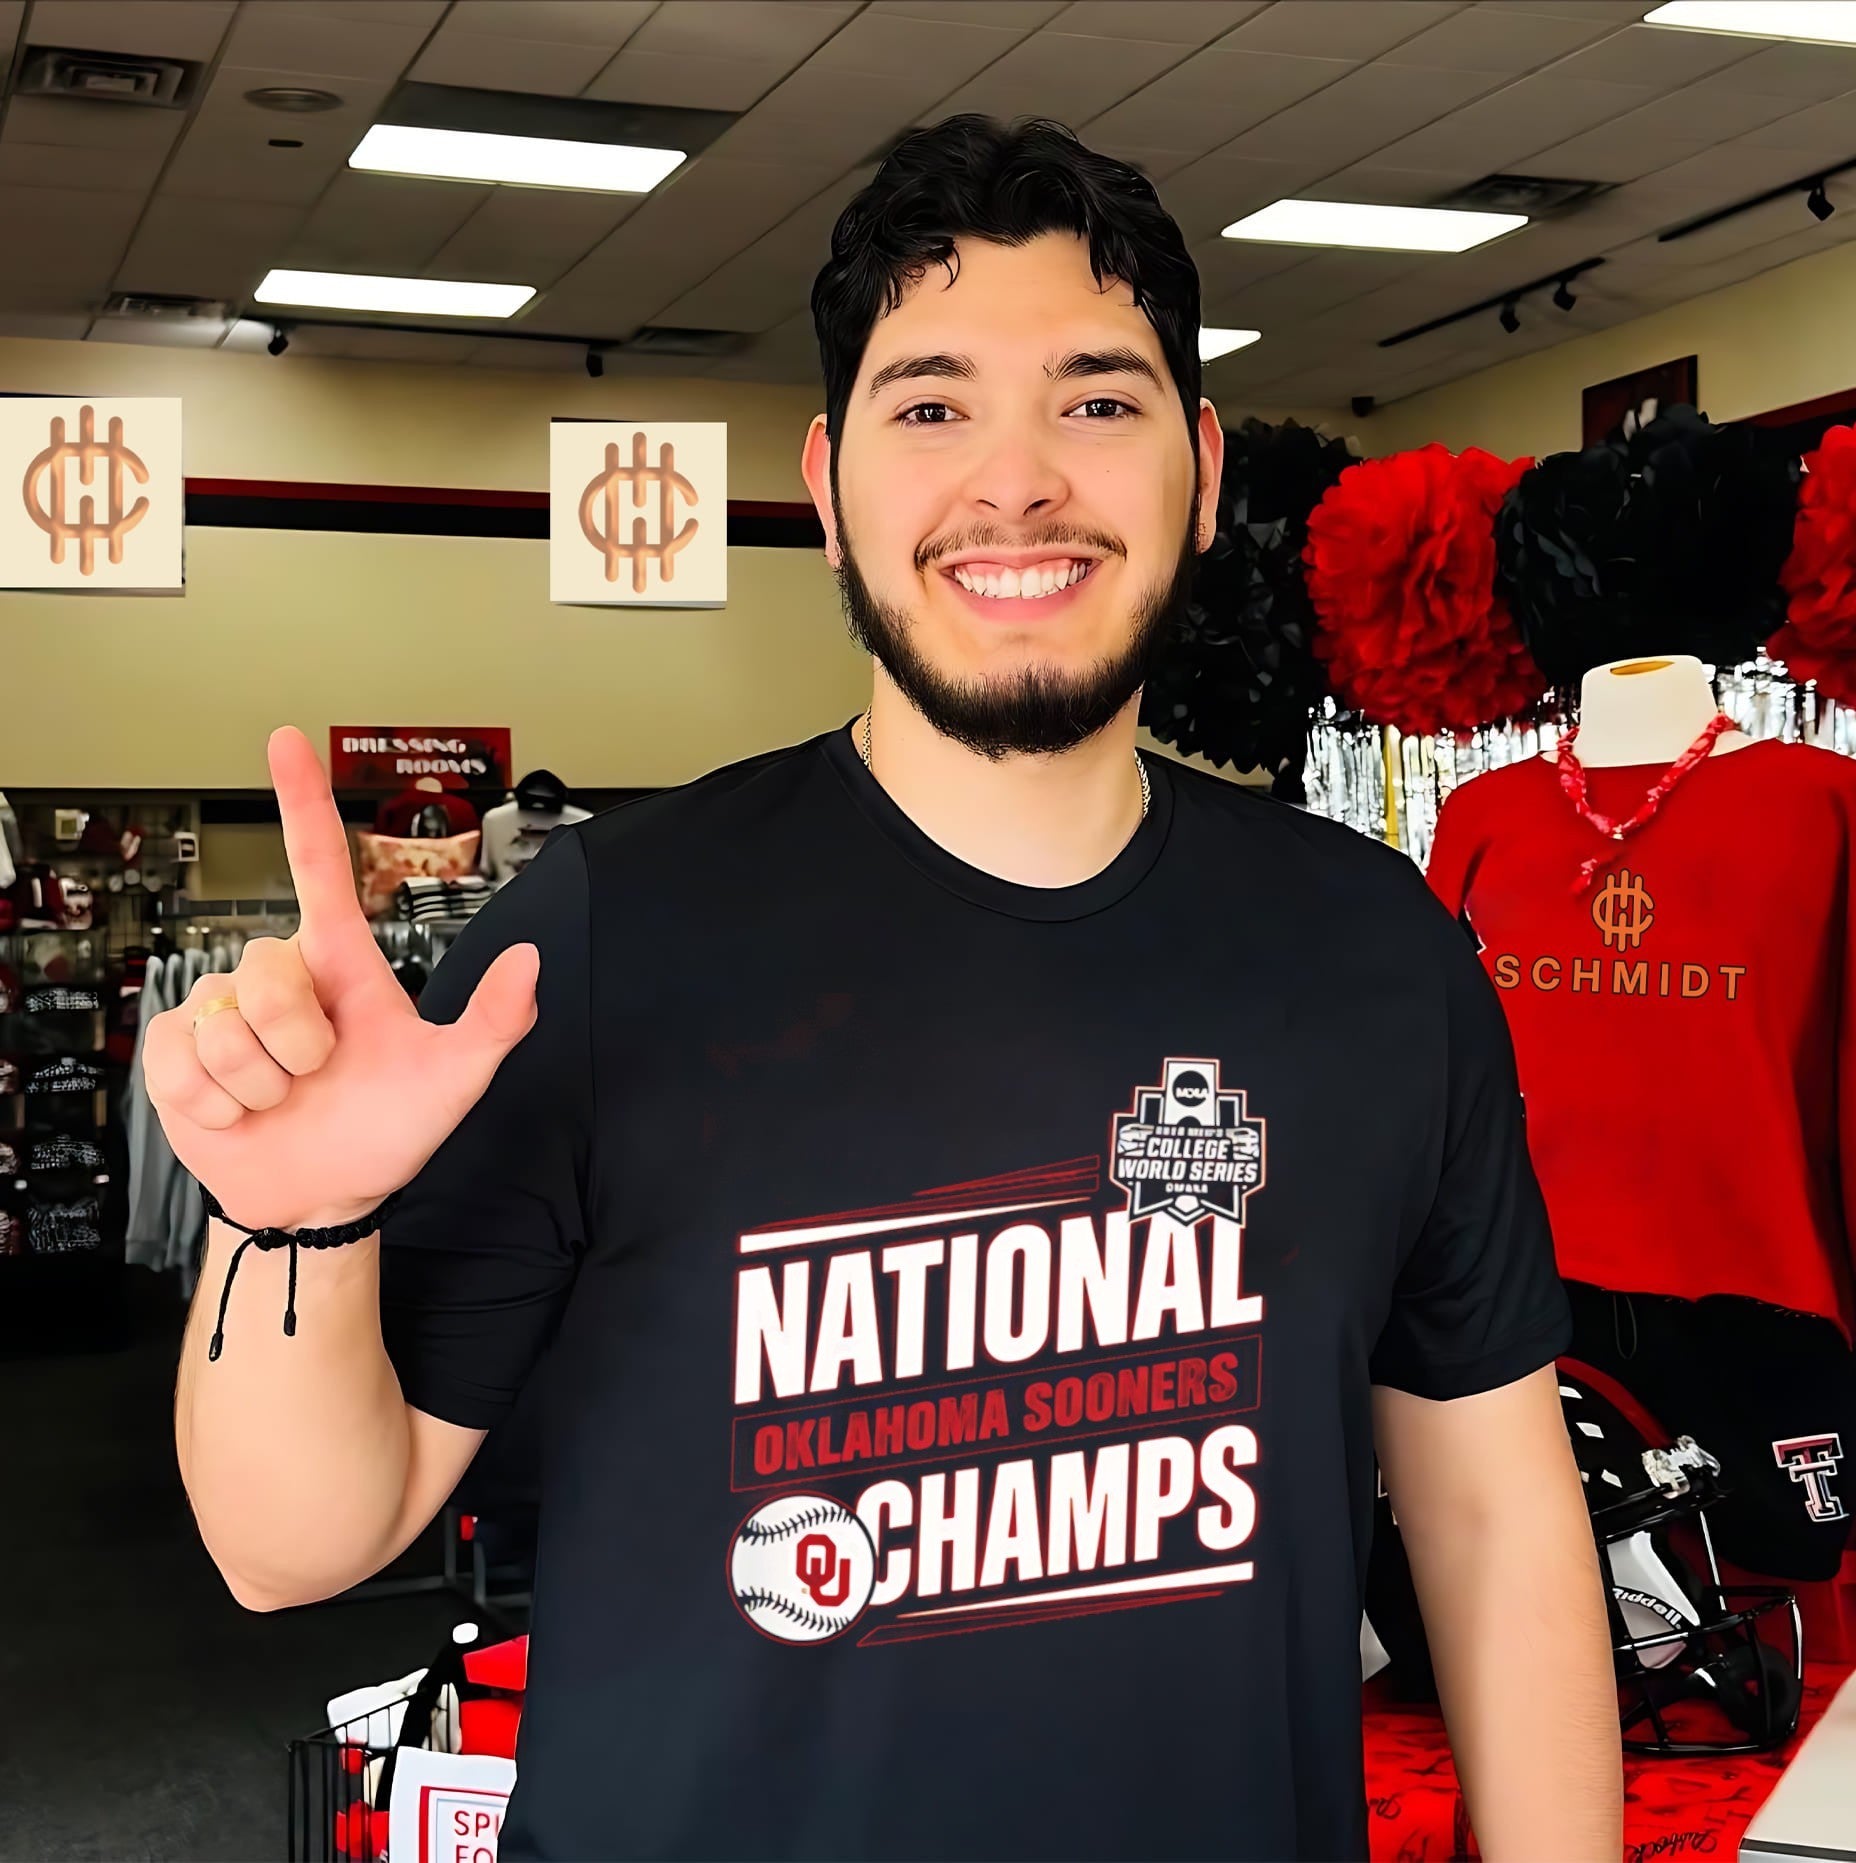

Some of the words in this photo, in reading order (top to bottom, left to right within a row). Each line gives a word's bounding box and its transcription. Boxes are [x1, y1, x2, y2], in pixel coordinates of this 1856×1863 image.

[396, 758, 487, 775] ROOMS
[1494, 953, 1747, 1000] SCHMIDT
[1118, 1158, 1187, 1180] WORLD
[1189, 1161, 1258, 1184] SERIES
[1146, 1136, 1231, 1160] COLLEGE
[734, 1210, 1263, 1405] NATIONAL
[753, 1389, 1010, 1476] OKLAHOMA
[1022, 1352, 1239, 1432] SOONERS
[856, 1424, 1259, 1606] CHAMPS
